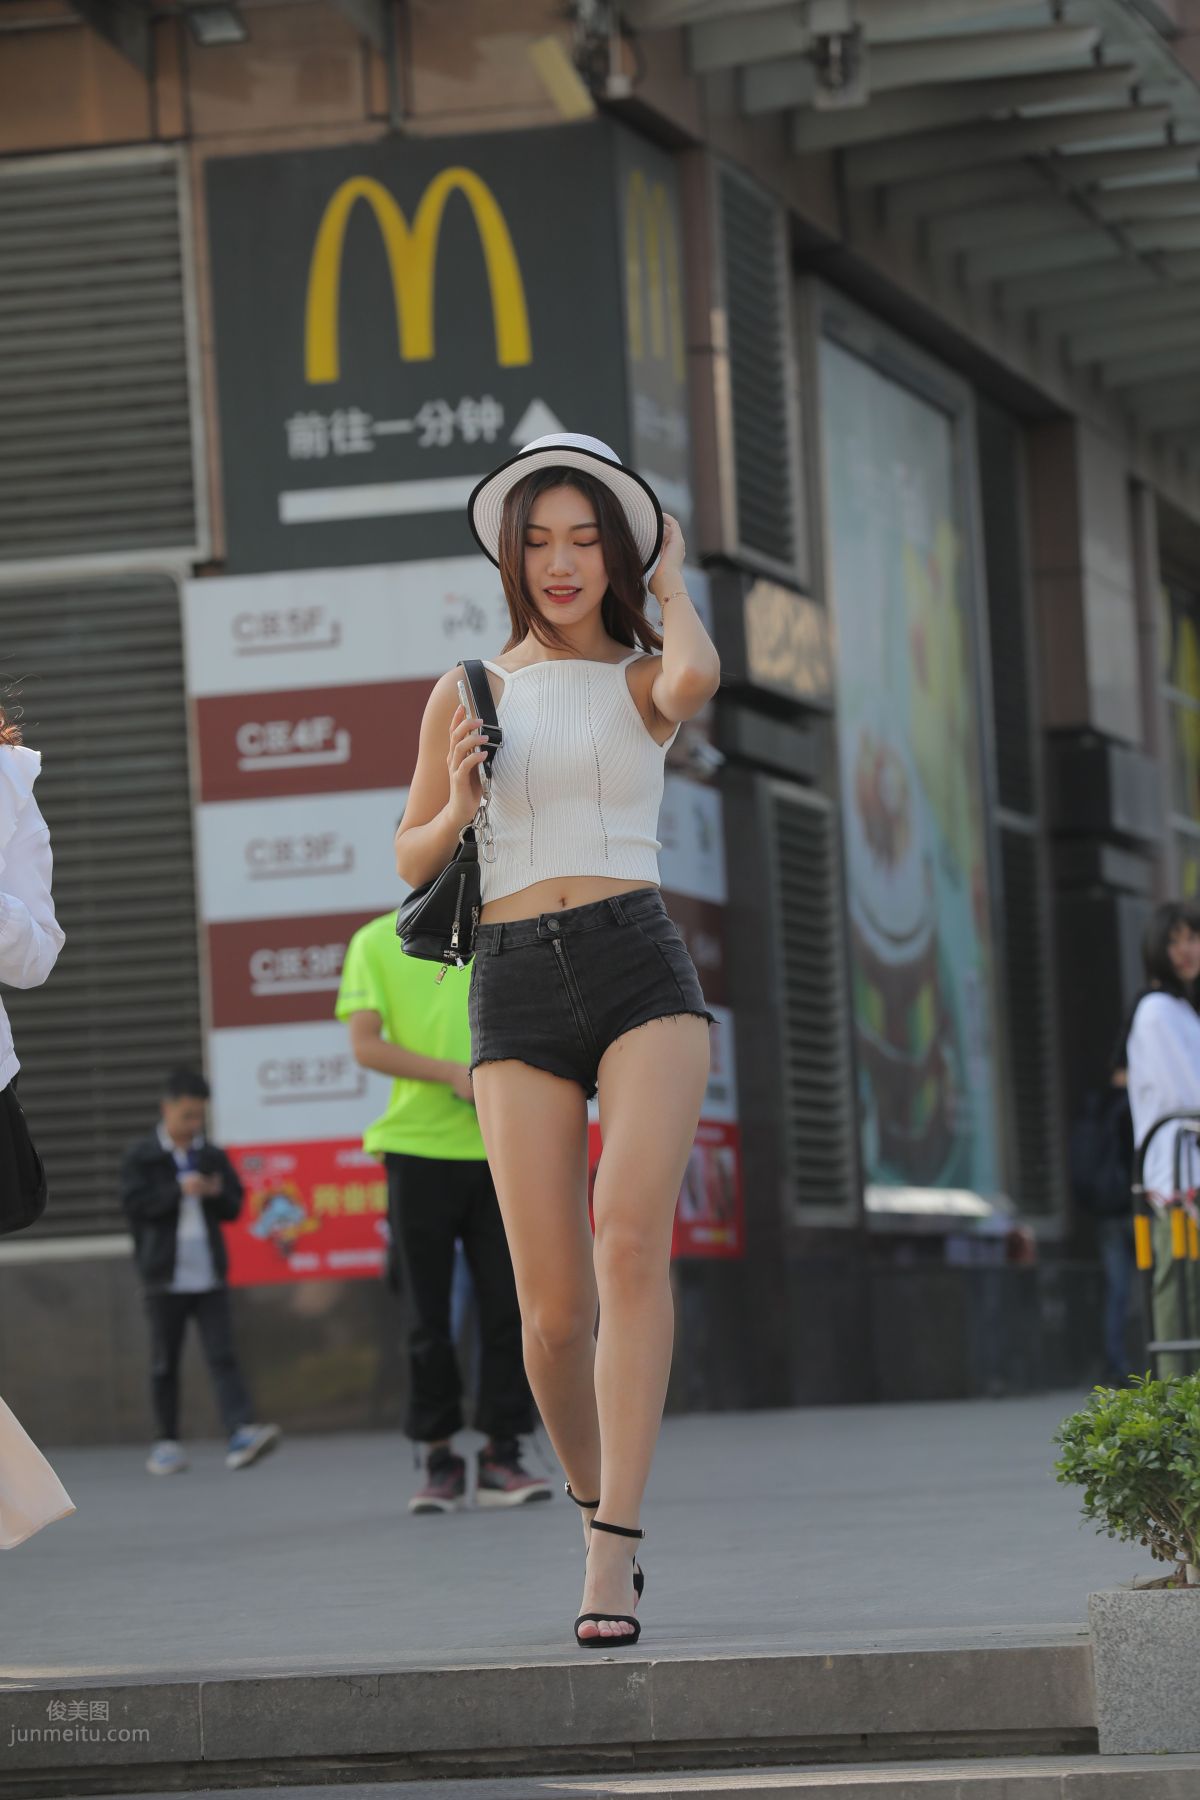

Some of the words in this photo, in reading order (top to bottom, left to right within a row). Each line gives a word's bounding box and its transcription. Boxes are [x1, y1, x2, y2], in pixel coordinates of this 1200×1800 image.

[284, 394, 505, 460] 前往一分钟
